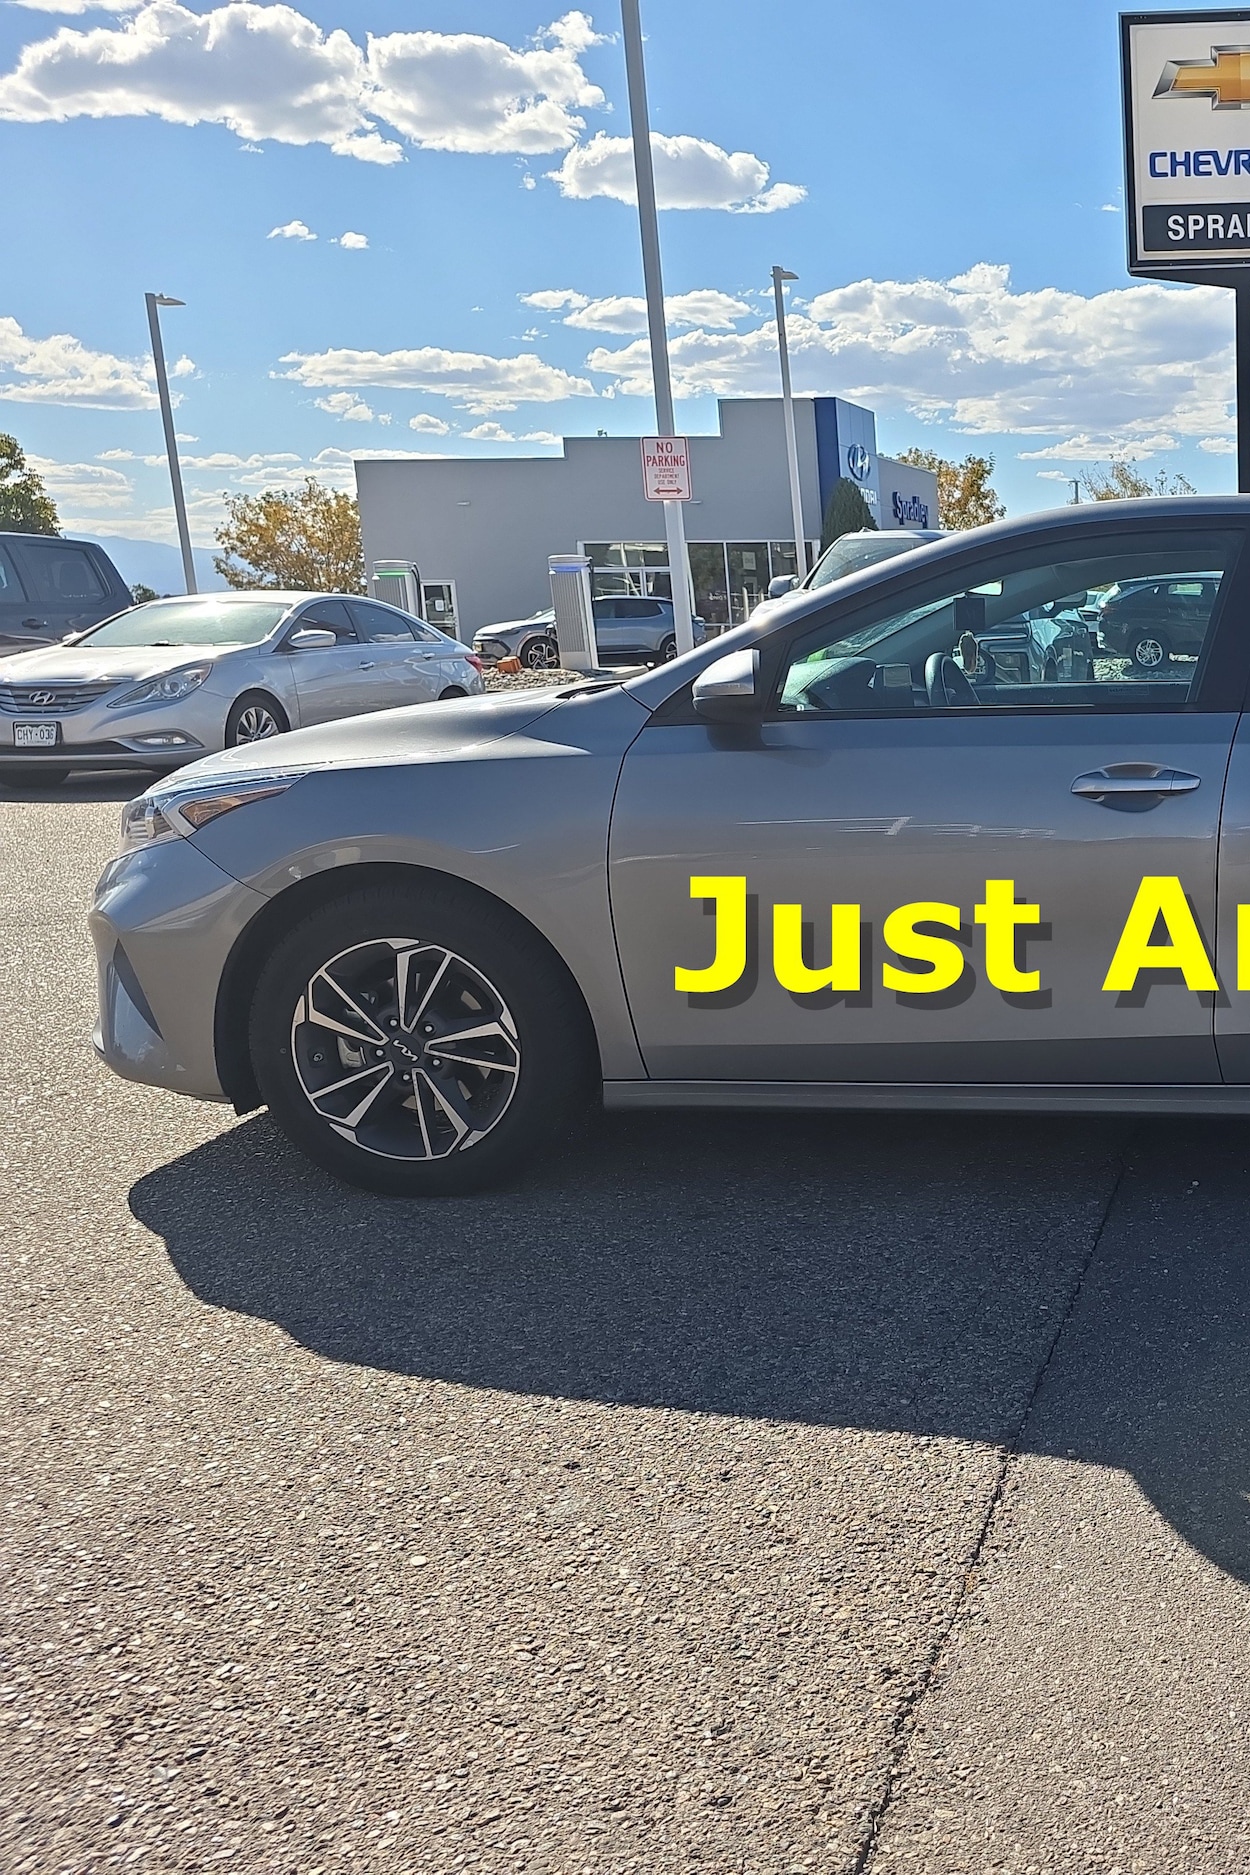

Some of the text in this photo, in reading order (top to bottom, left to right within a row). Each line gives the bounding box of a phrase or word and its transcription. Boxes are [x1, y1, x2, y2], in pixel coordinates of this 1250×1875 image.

[656, 441, 673, 453] NO
[646, 455, 685, 467] PARKING
[892, 490, 929, 529] Spradley
